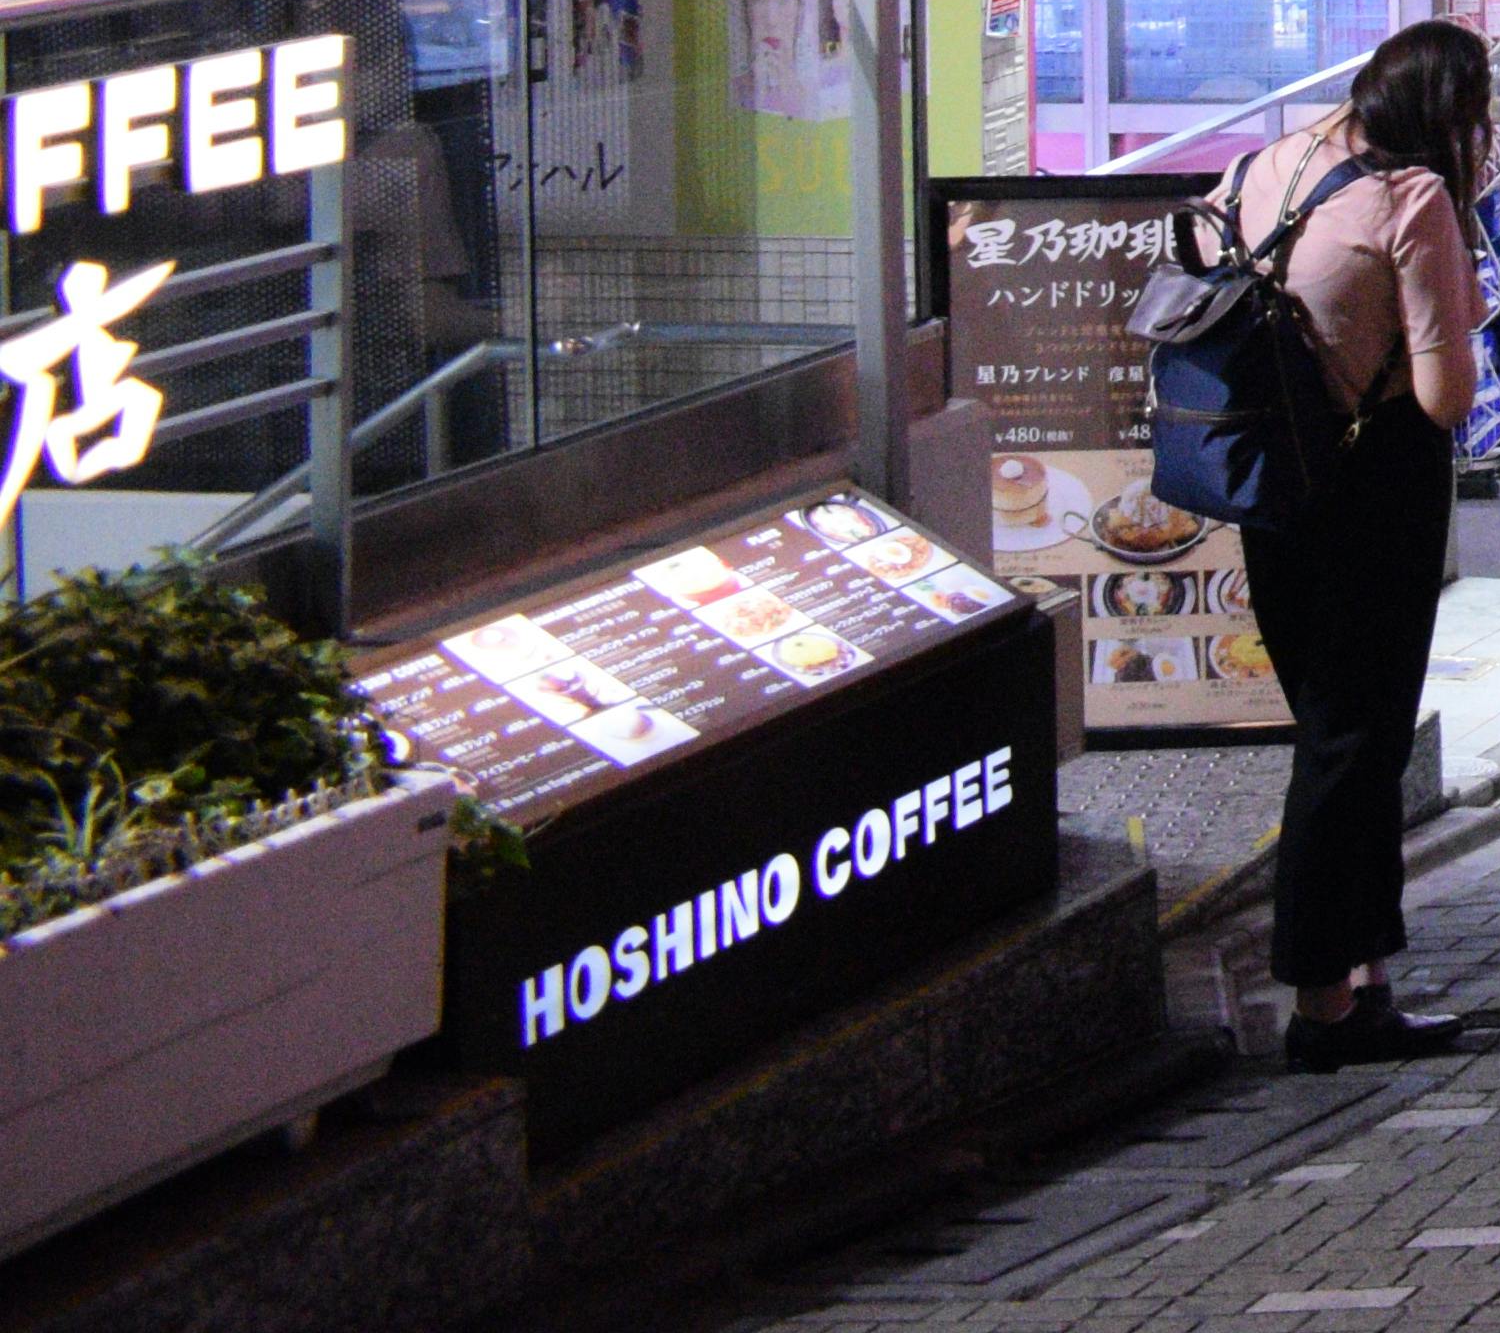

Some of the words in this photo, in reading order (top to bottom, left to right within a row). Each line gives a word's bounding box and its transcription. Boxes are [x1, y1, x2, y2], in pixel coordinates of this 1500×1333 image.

[8, 34, 349, 235] FFEE
[965, 214, 1178, 270] 星乃珈琲
[987, 281, 1143, 309] ハンドドリッ
[976, 364, 1090, 384] 星乃ブレンド
[1108, 365, 1146, 383] 彦星
[1118, 422, 1152, 441] ¥48
[519, 851, 803, 1048] HOSHINO
[812, 746, 1014, 902] COFFEE
